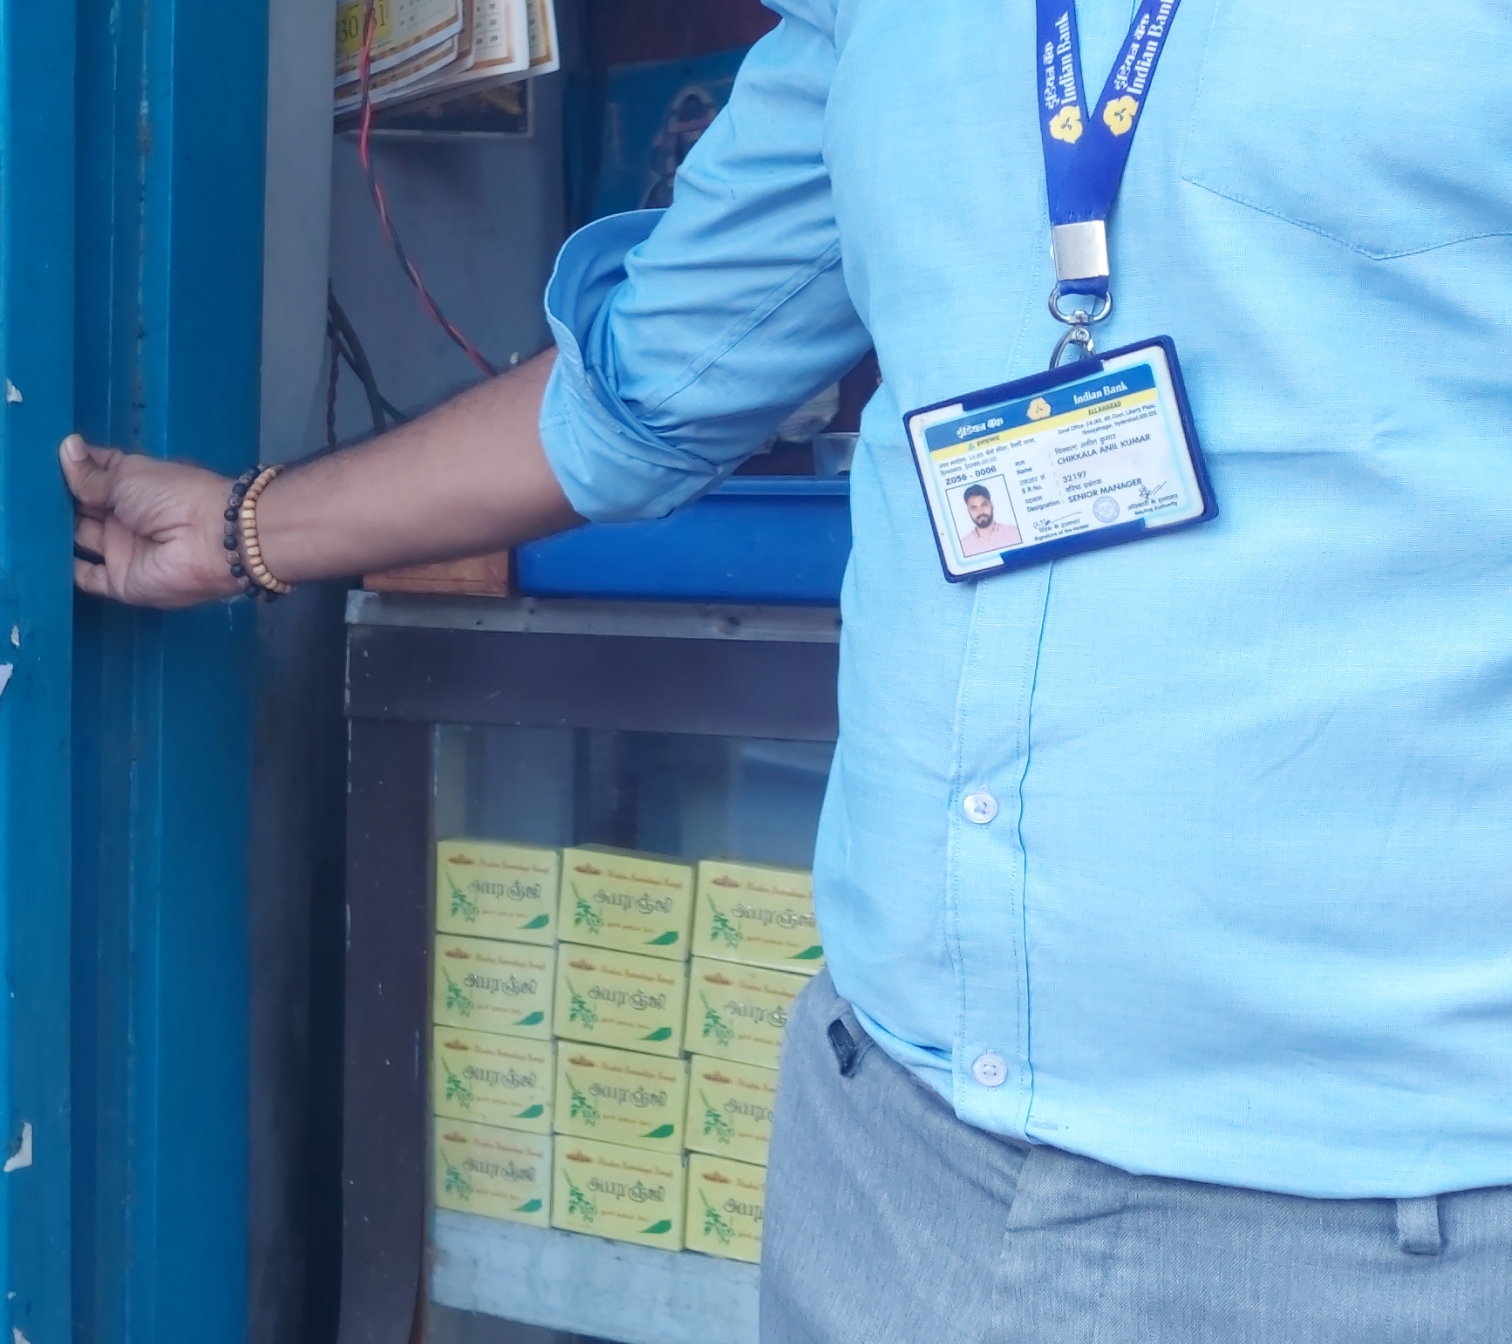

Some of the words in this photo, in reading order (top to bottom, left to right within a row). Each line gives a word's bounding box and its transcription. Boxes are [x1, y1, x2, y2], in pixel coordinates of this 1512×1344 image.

[1055, 11, 1071, 56] Bank
[1059, 53, 1077, 105] Indian
[1127, 40, 1159, 95] Indian
[1074, 390, 1102, 405] Indian
[1103, 381, 1128, 396] Bank
[1057, 448, 1097, 465] CHIKKALA
[1100, 444, 1118, 454] ANIL
[1120, 434, 1151, 448] KUMAR
[1016, 467, 1032, 475] Name
[1062, 471, 1087, 484] 32197
[1068, 489, 1098, 504] SENIOR
[1100, 477, 1143, 495] MANAGER
